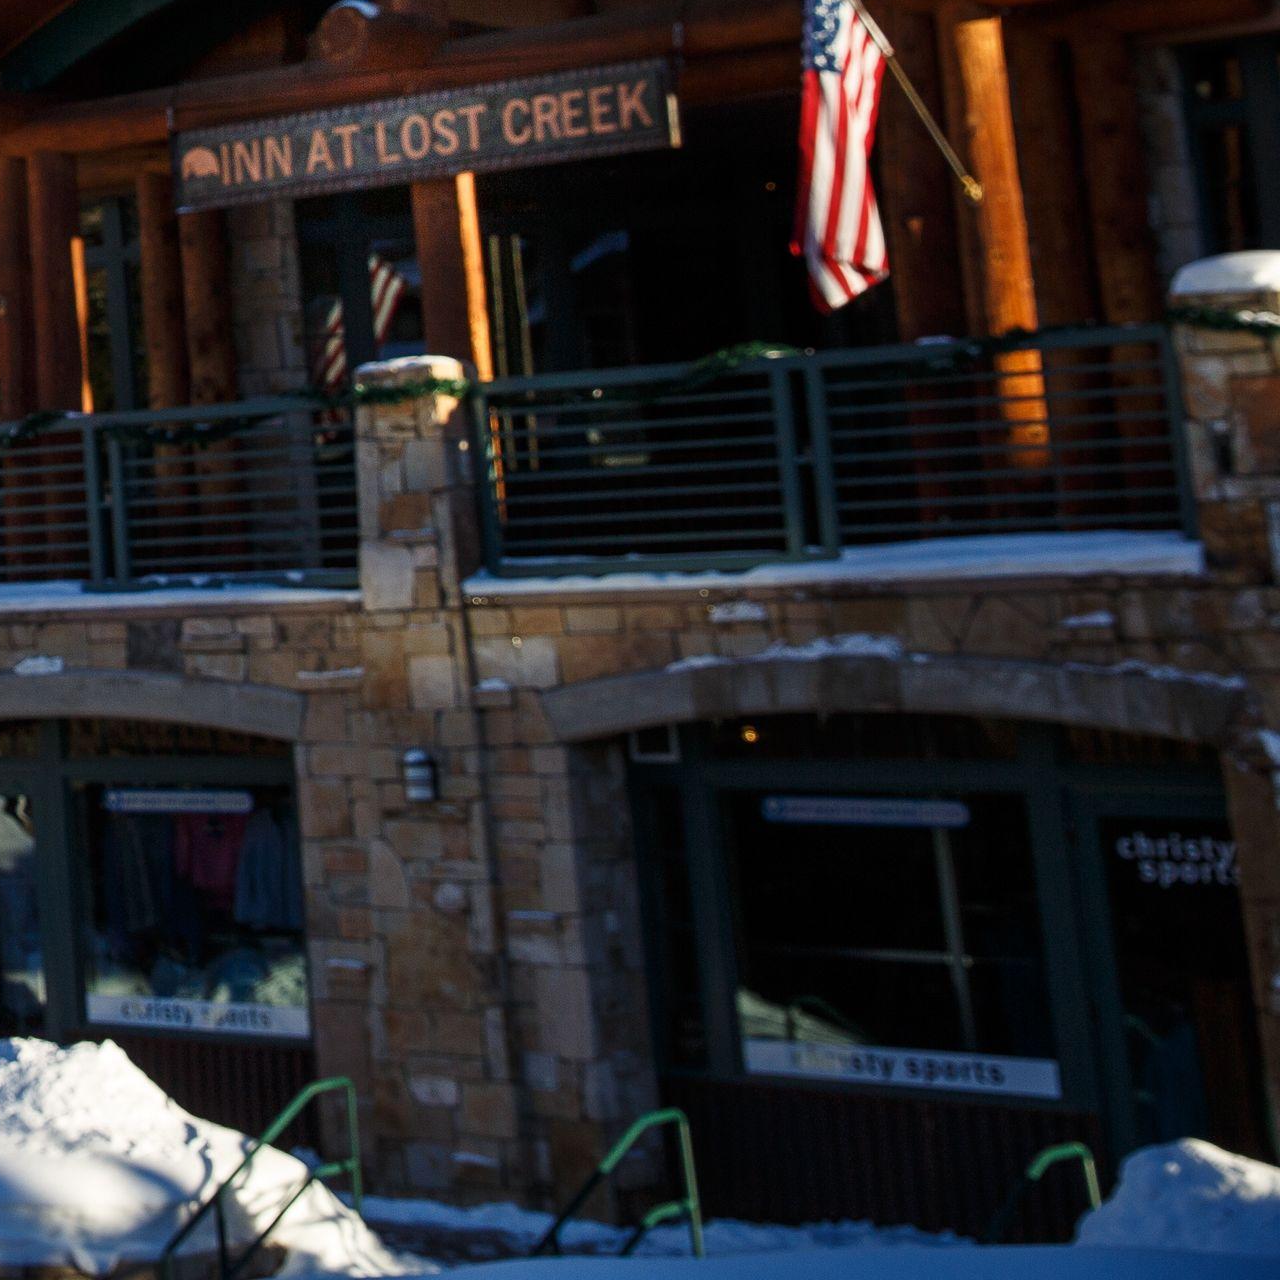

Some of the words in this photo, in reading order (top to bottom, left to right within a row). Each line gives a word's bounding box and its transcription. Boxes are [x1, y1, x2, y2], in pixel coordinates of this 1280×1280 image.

[218, 133, 293, 187] INN
[306, 125, 362, 173] AT
[374, 102, 488, 165] LOST
[501, 79, 654, 146] CREEK
[1116, 830, 1237, 869] christy
[903, 1056, 1006, 1087] sports
